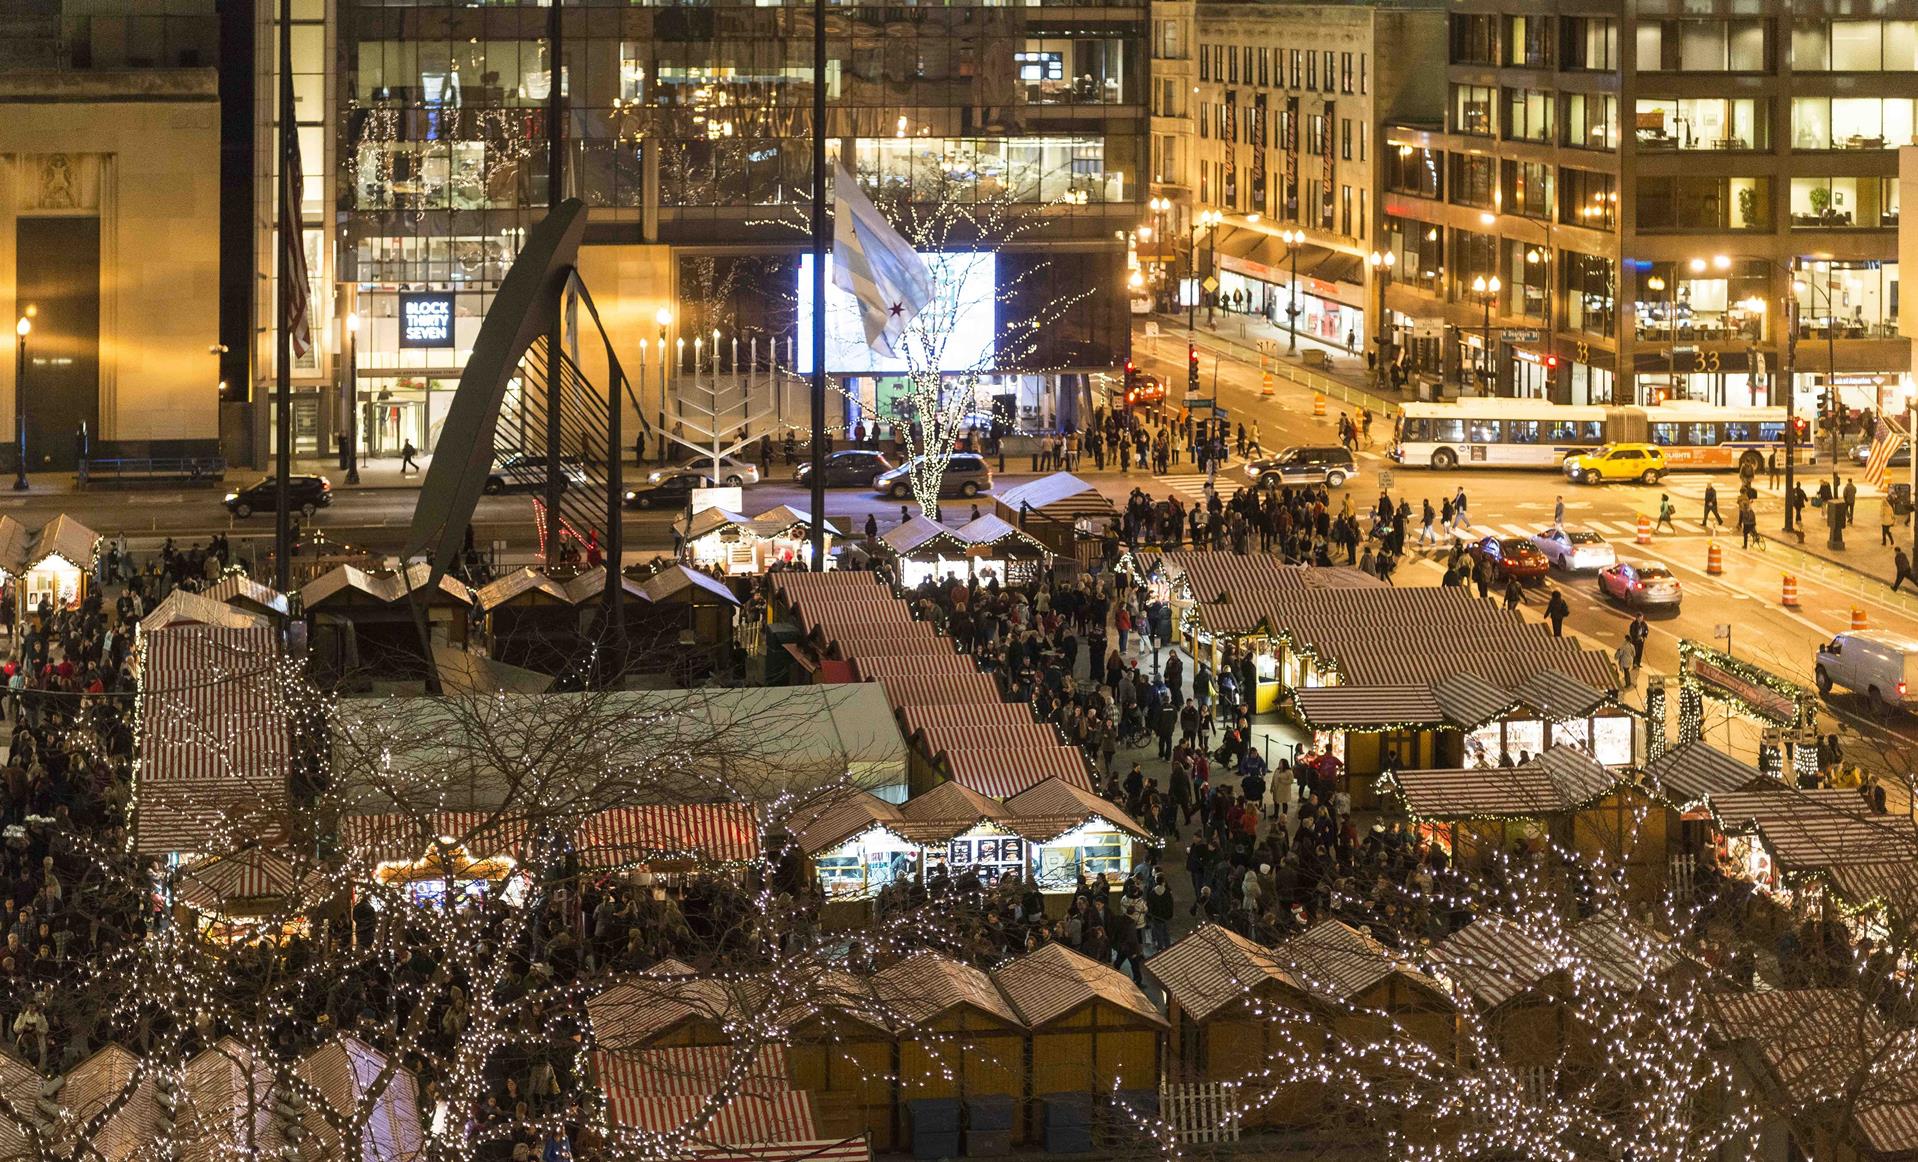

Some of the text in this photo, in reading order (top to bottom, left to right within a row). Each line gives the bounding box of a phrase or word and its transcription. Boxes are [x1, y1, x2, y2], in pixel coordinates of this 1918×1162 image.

[405, 301, 449, 314] BLOCK
[406, 314, 449, 326] THIRTY
[405, 326, 447, 339] SEVEN
[1577, 340, 1588, 364] 33
[1694, 351, 1720, 373] 33
